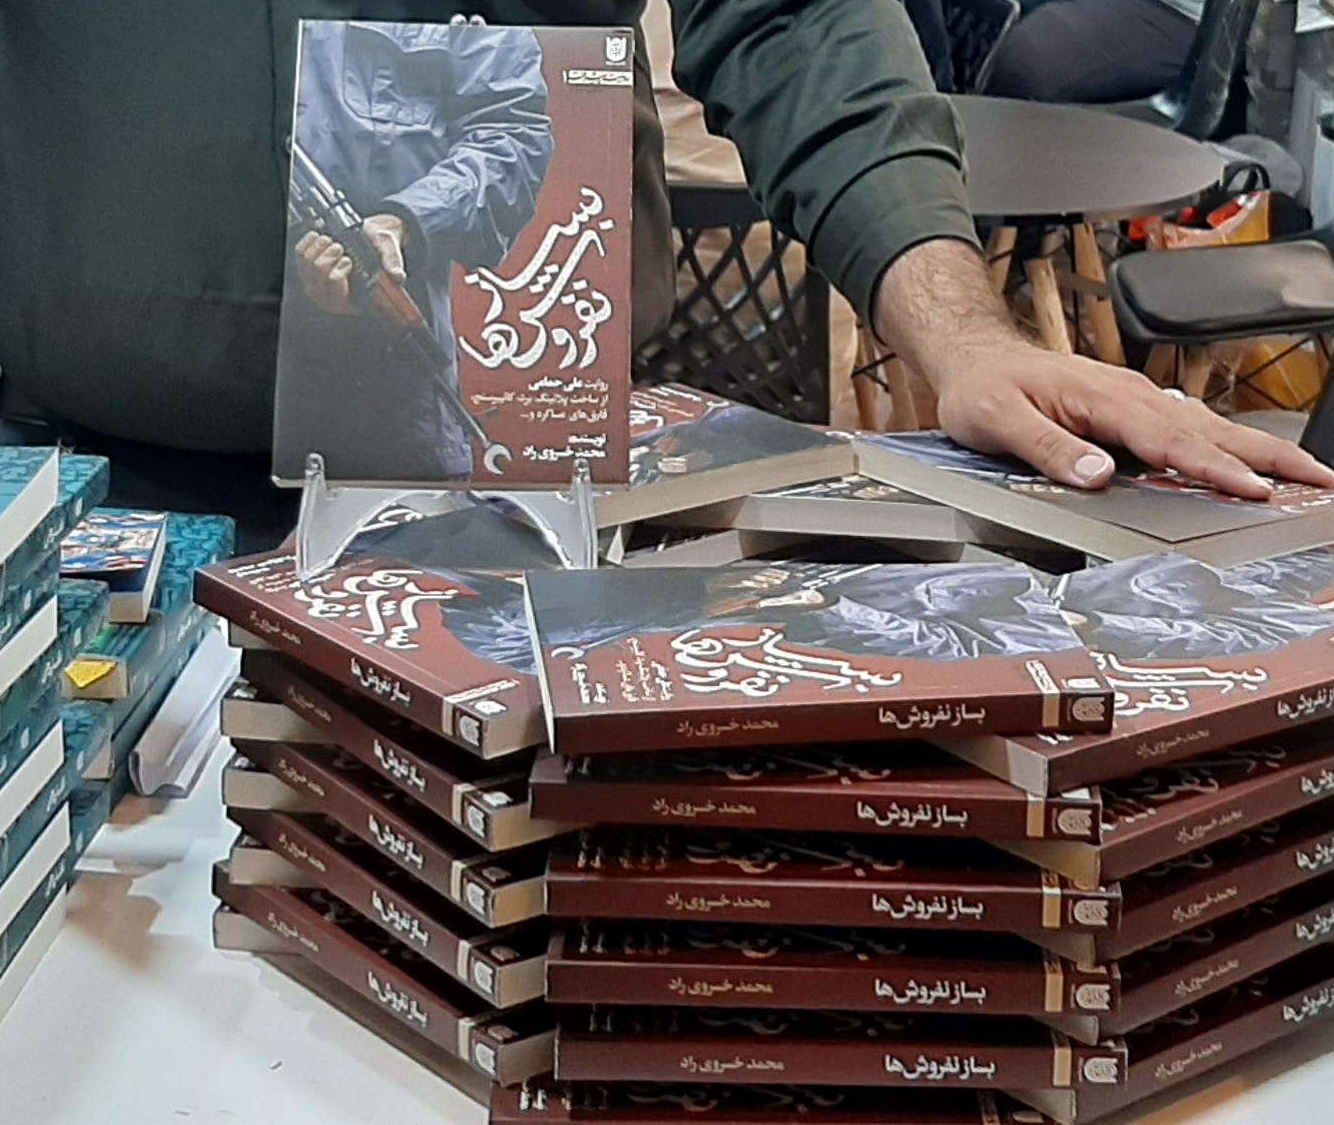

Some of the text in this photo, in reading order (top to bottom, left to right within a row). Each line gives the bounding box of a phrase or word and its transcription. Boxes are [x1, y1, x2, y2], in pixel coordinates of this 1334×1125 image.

[537, 444, 574, 461] خسروی
[574, 447, 606, 457] محمد
[877, 704, 986, 729] بساز نفروش‌ها
[677, 717, 779, 737] محمد خسروی راد
[652, 797, 756, 817] محمد خسروی راد
[856, 801, 968, 827] بساز نفروش‌ها
[666, 891, 770, 911] محمد خسروی راد
[872, 894, 983, 919] بساز نفروش‌ها
[668, 976, 772, 996] محمد خسروی راد
[875, 979, 986, 1004] بساز نفروش‌ها
[679, 1054, 784, 1073] محمد خسروی راد
[885, 1054, 995, 1079] بساز نفروش‌ها
